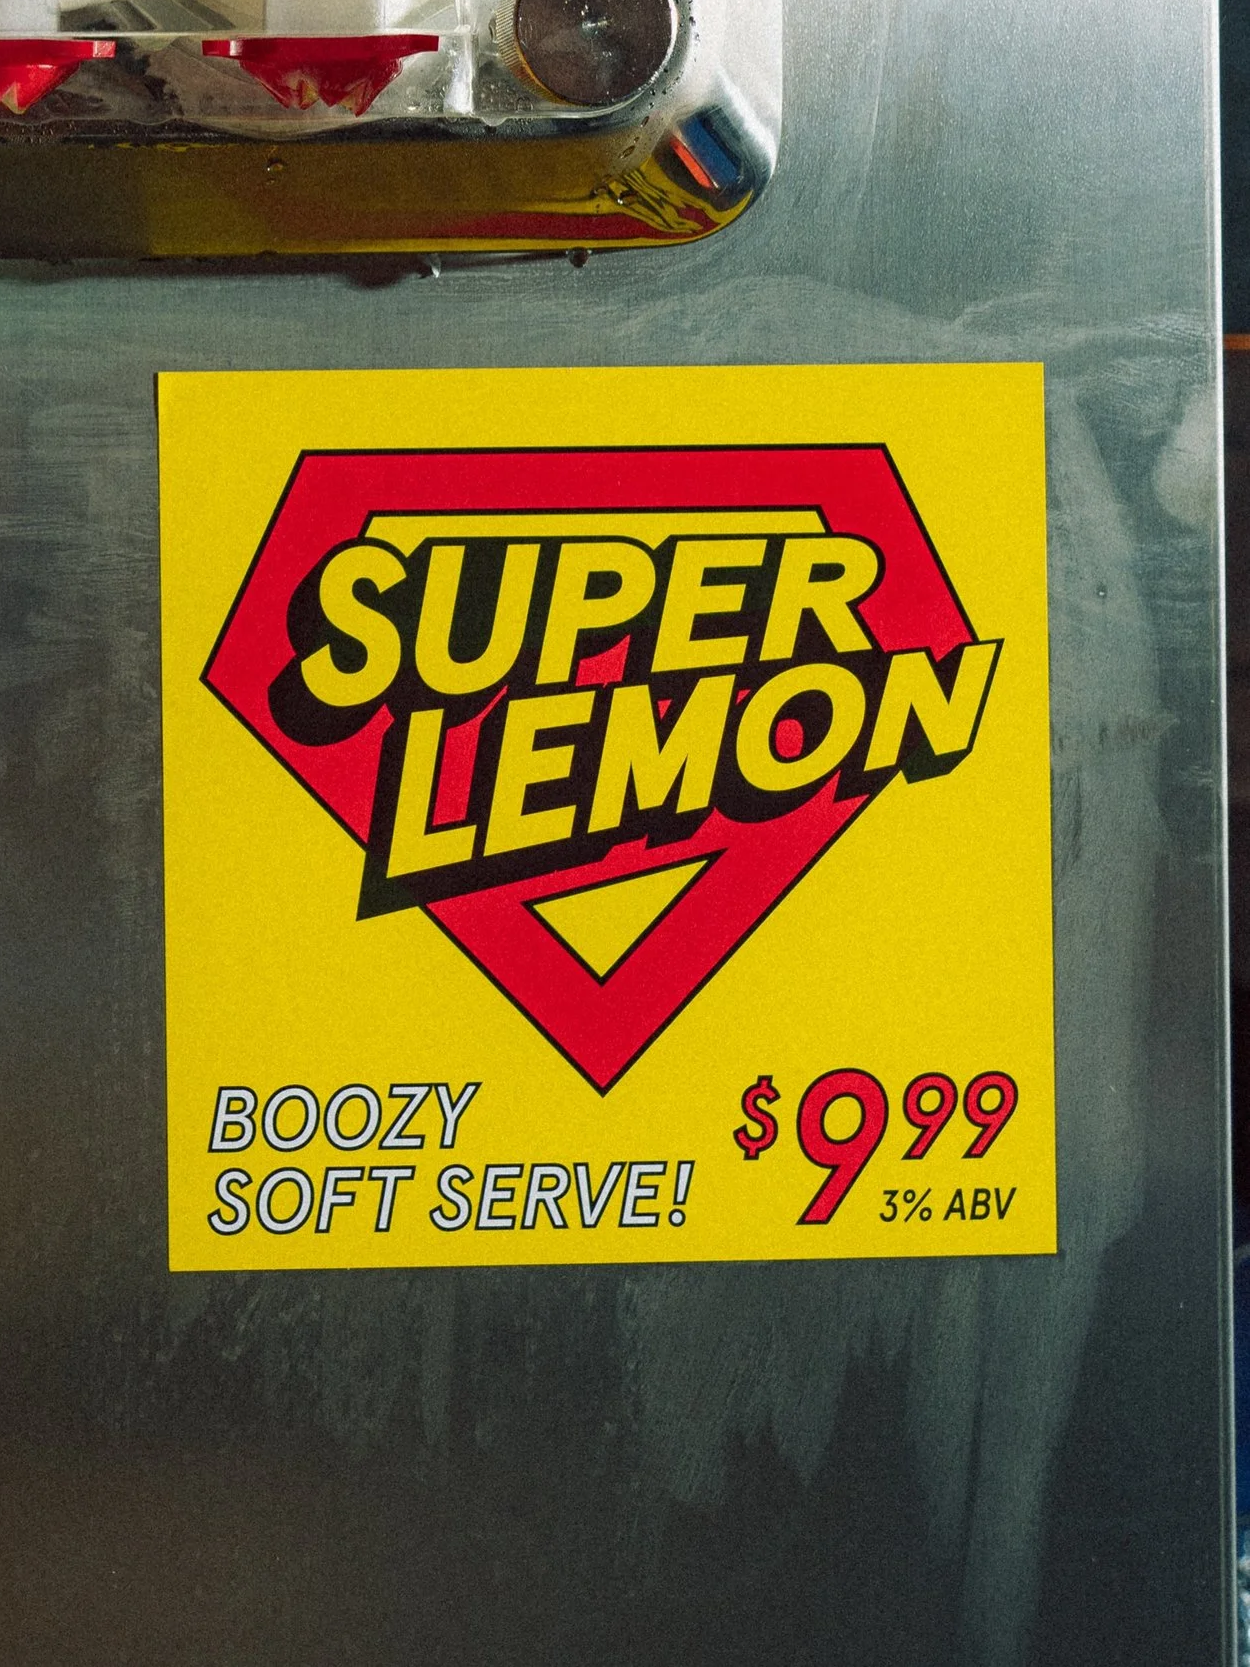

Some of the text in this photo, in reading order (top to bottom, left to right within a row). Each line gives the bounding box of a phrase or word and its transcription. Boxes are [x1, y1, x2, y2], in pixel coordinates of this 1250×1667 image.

[296, 533, 884, 712] SUPER
[380, 637, 1004, 884] LEMON
[207, 1081, 483, 1154] BOOZY
[207, 1160, 696, 1237] SOFT SERVE!
[879, 1187, 1018, 1224] 3% ABV
